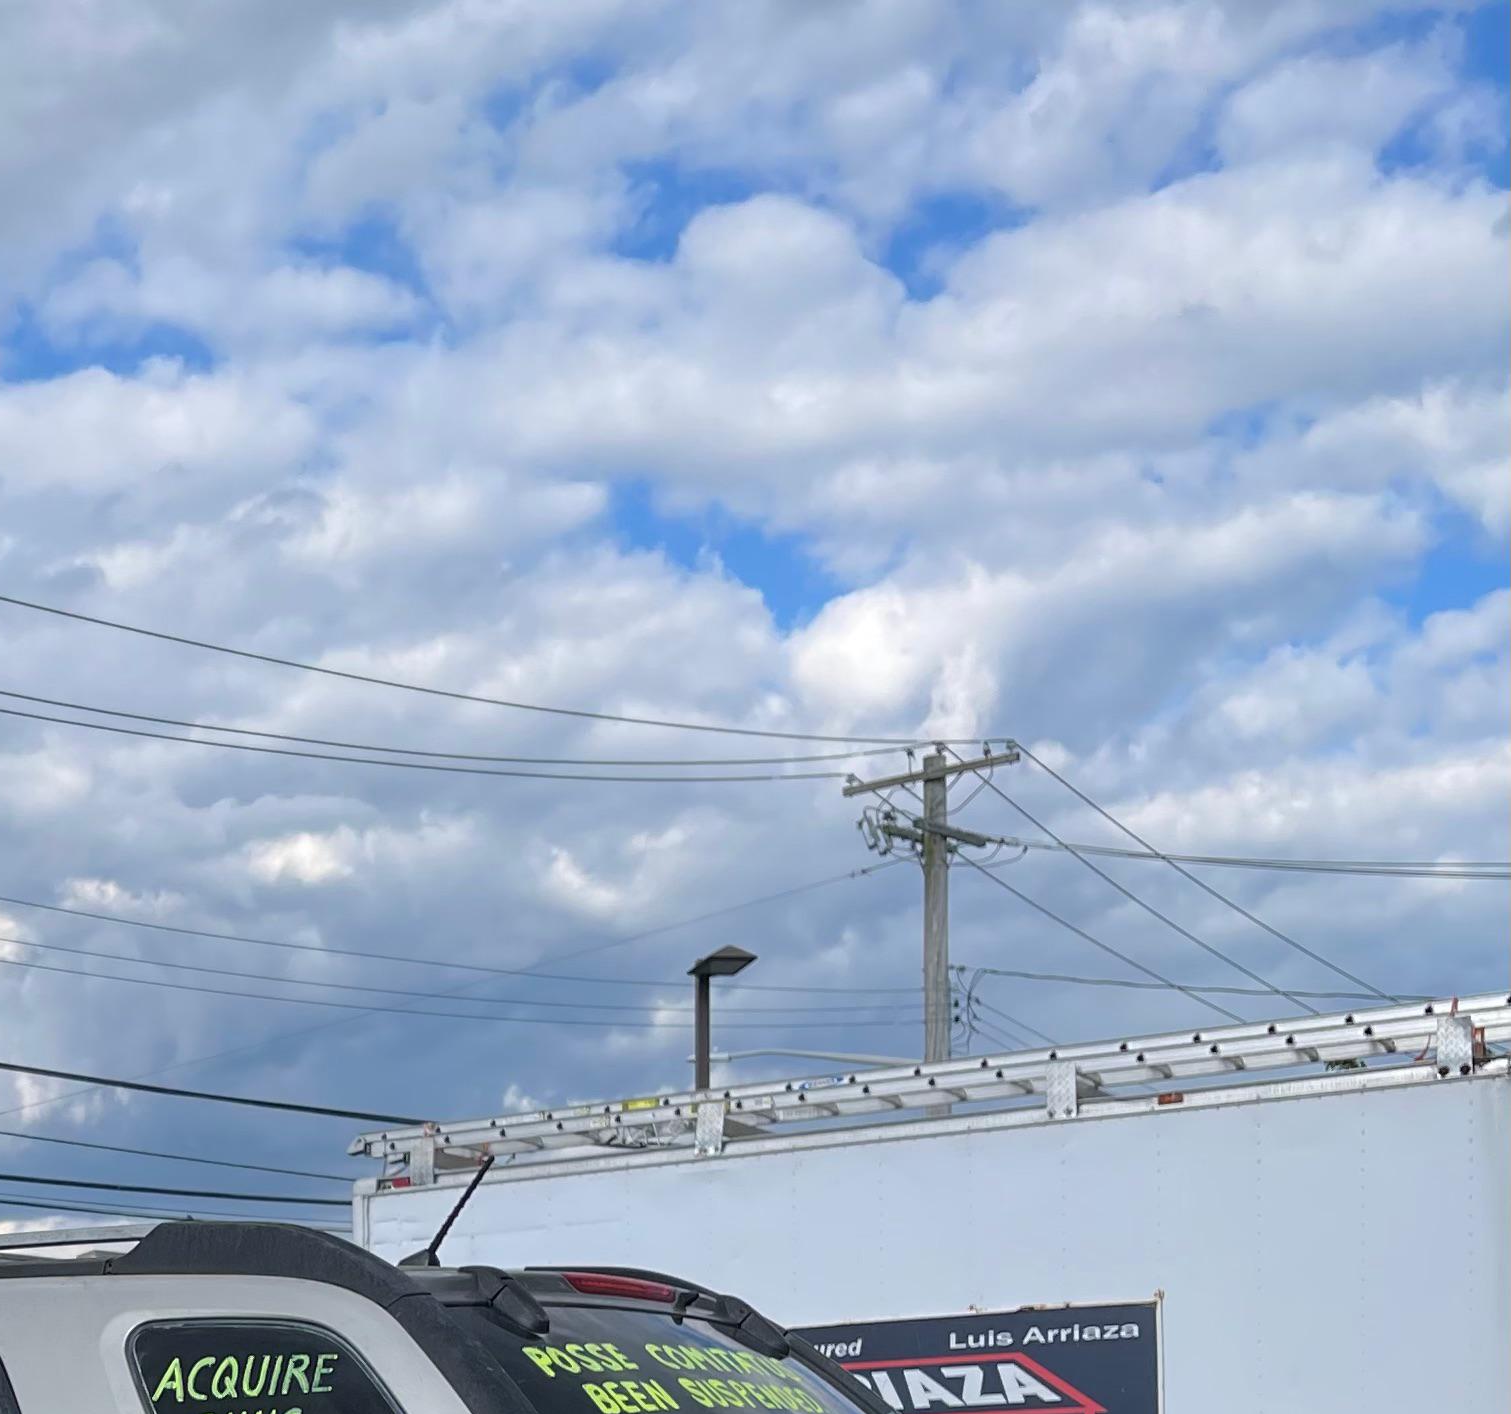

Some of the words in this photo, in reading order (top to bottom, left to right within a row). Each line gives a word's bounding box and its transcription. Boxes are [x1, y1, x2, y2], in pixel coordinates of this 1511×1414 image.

[949, 1329, 1014, 1349] Luis
[1022, 1322, 1139, 1345] Arriaza
[151, 1353, 338, 1402] ACQUIRE
[522, 1343, 638, 1378] POSSE
[582, 1378, 680, 1414] BEEN
